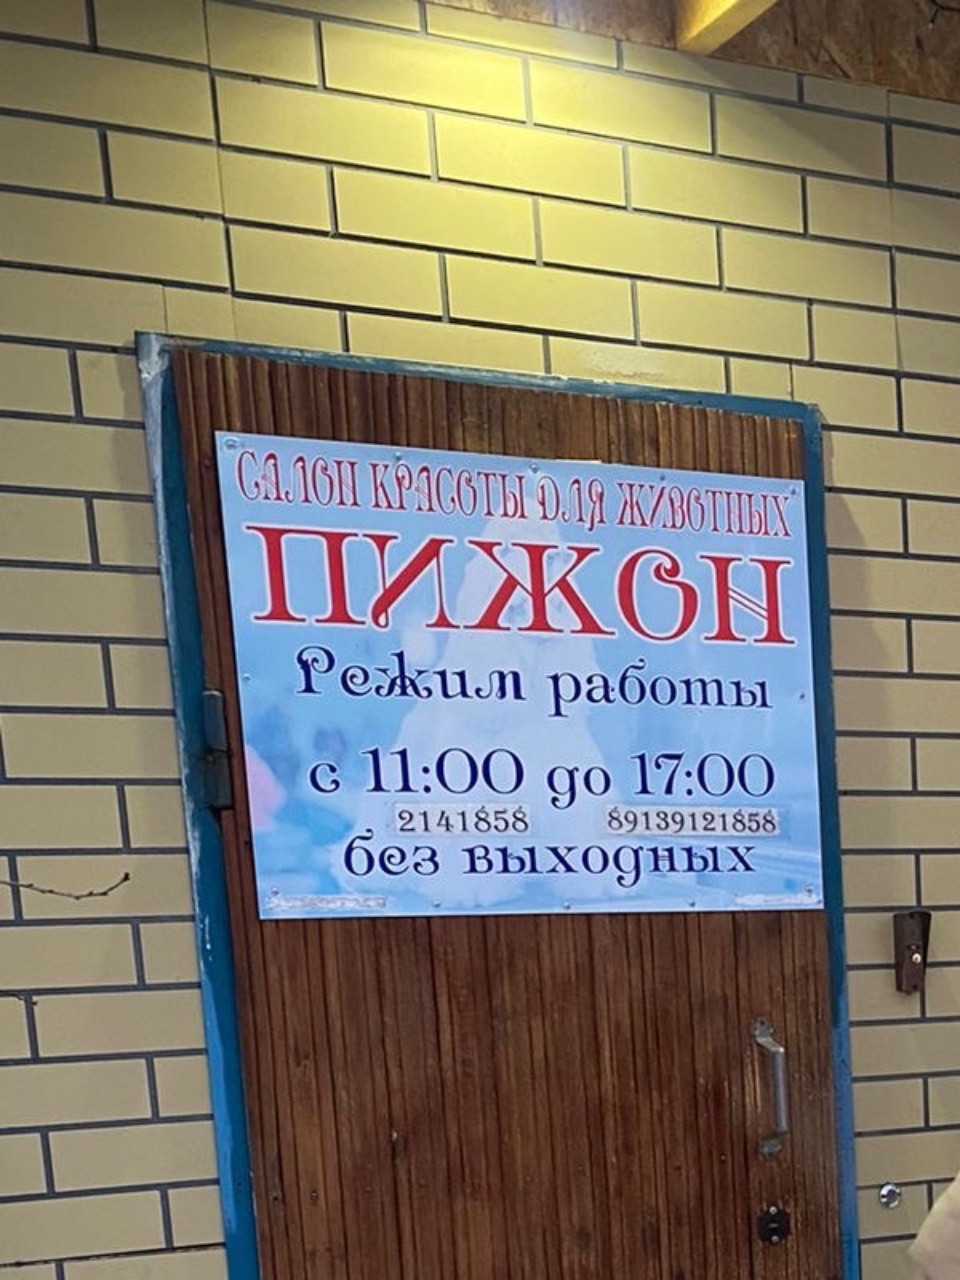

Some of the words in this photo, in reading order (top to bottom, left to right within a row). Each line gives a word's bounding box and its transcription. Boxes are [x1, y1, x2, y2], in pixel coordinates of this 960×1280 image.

[237, 450, 361, 508] САЛОН
[368, 462, 528, 519] КРАСОТЫ
[537, 476, 606, 532] ДЛЯ
[616, 482, 793, 538] ЖИВОТНЫХ
[246, 526, 796, 645] ПИЖОН
[296, 645, 527, 698] Режим
[547, 659, 773, 717] работы
[308, 762, 342, 795] с
[362, 747, 525, 795] 11:00
[547, 765, 612, 808] до
[630, 752, 775, 797] 17:00
[397, 806, 529, 833] 2141858
[607, 806, 777, 833] 89139121858
[344, 829, 440, 876] без
[462, 844, 756, 888] выходных
